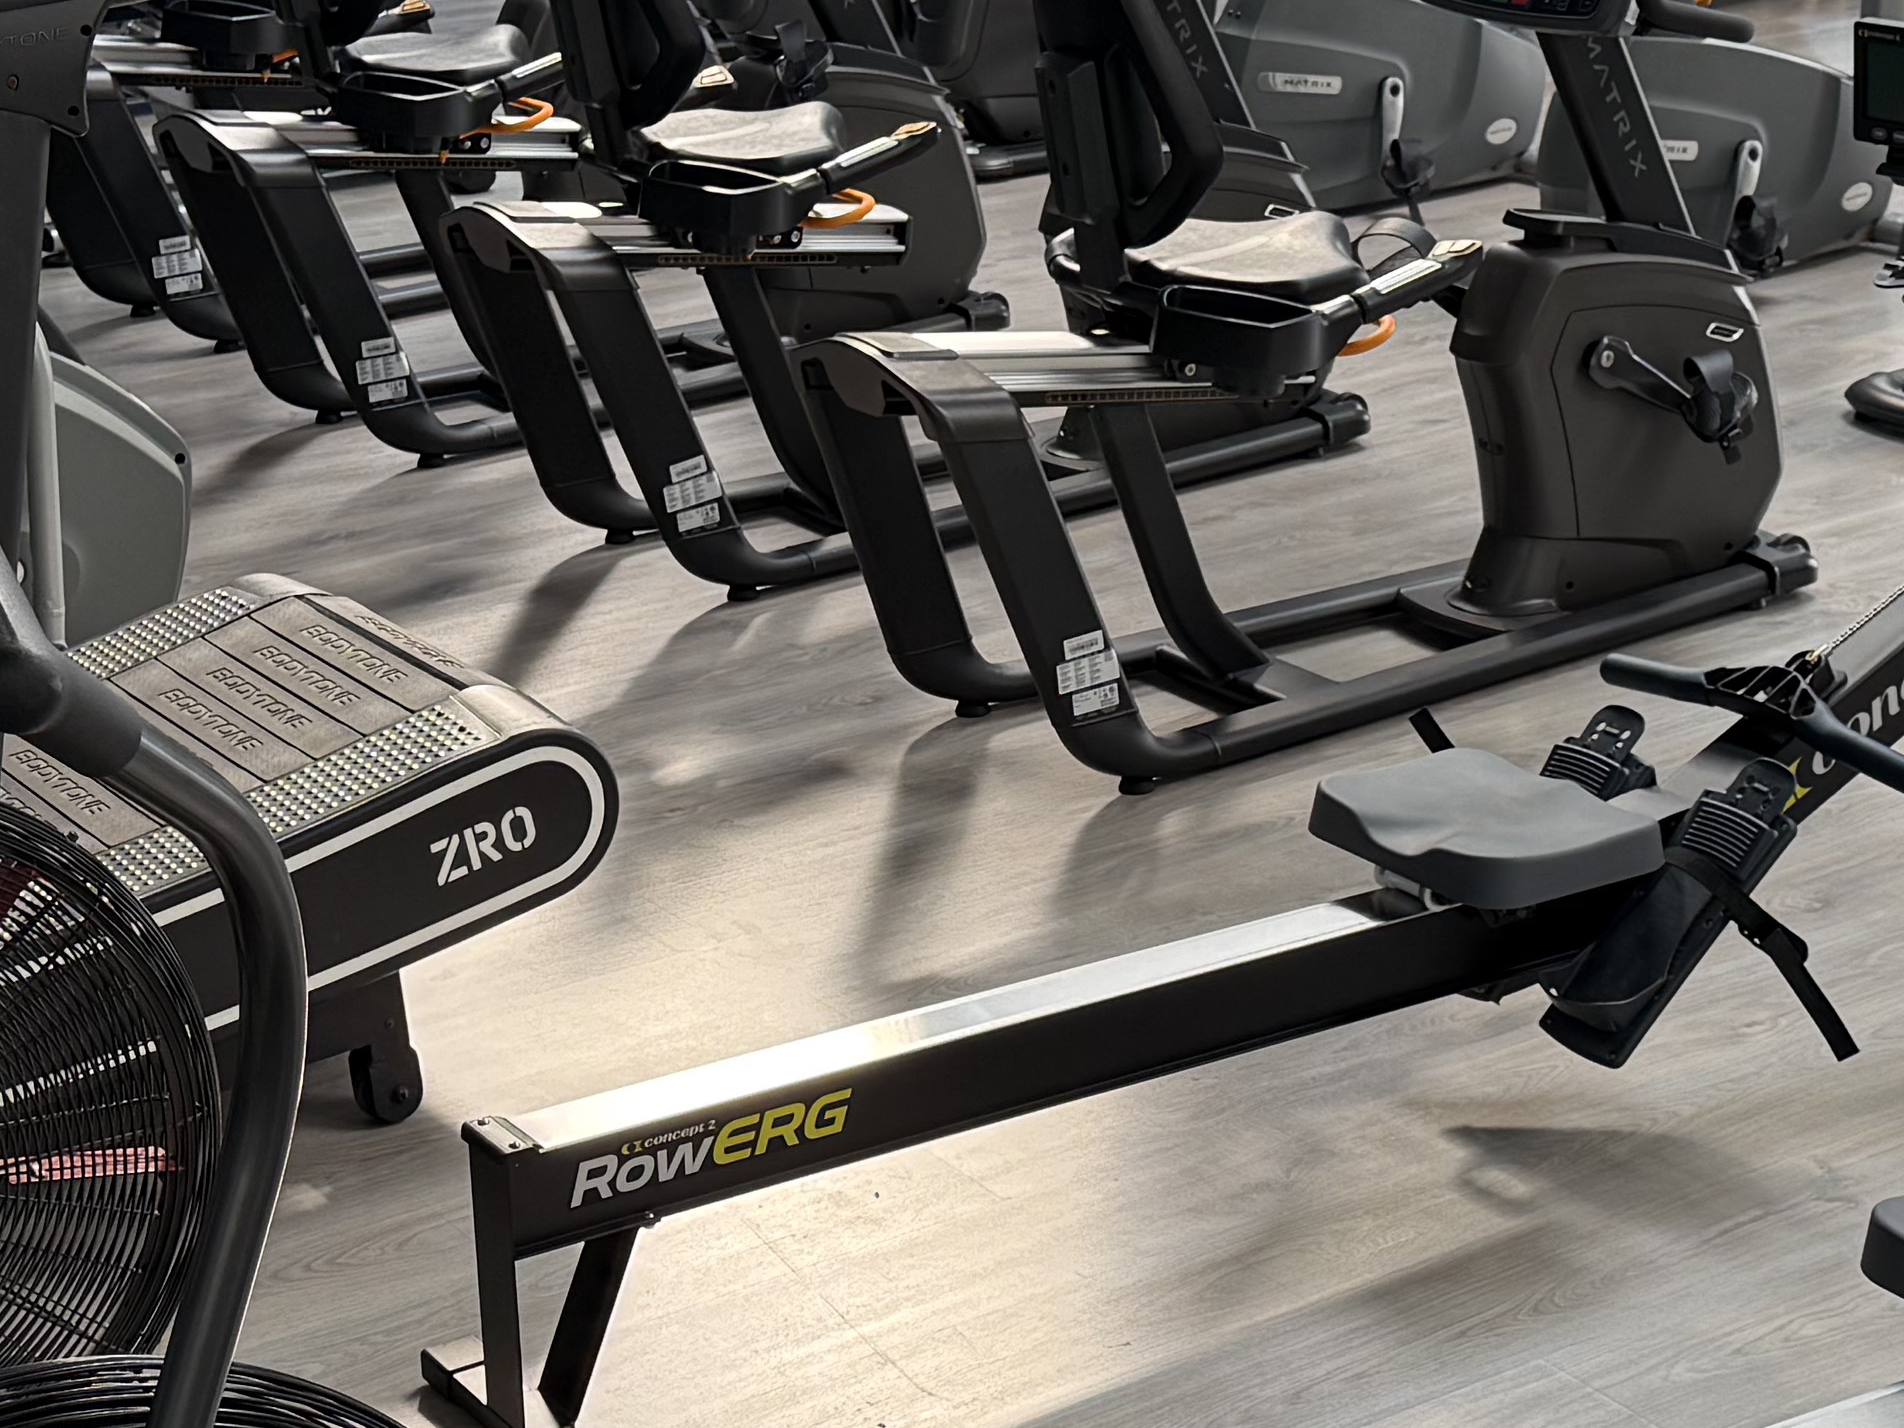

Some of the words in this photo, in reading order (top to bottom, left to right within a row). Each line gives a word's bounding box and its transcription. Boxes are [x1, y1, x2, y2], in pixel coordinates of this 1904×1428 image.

[1583, 34, 1647, 180] MATRIX
[252, 644, 362, 707] BODYTONE
[299, 623, 409, 685] BODYTONE
[157, 687, 265, 753] BODYTONE
[205, 666, 313, 730] BODYTONE
[8, 748, 112, 818] BODYTONE
[429, 806, 537, 887] ZRO
[644, 1123, 705, 1148] concept
